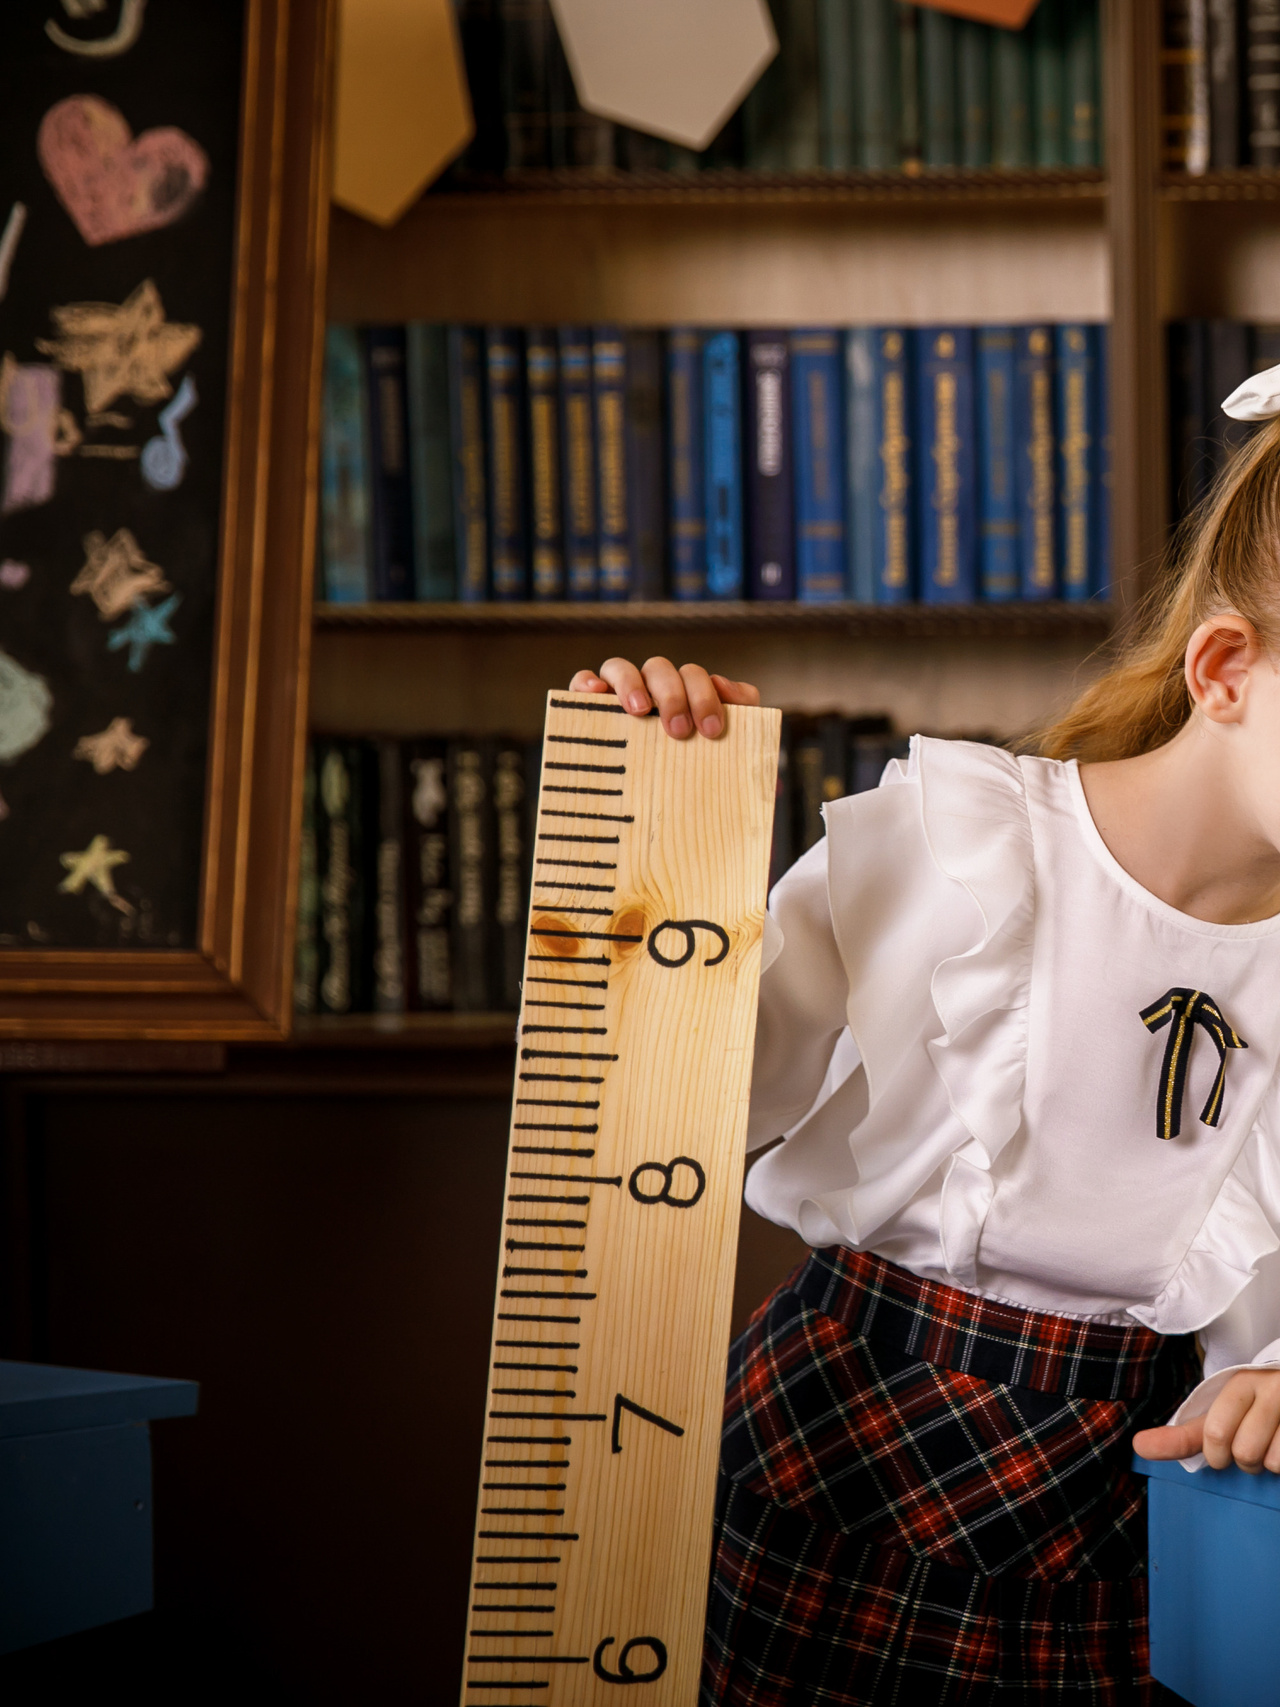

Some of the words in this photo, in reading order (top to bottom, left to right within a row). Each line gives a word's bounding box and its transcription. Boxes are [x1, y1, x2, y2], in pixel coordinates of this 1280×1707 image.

[647, 919, 730, 968] 9
[628, 1156, 706, 1209] 8
[611, 1393, 685, 1455] 7
[592, 1635, 669, 1687] 6
